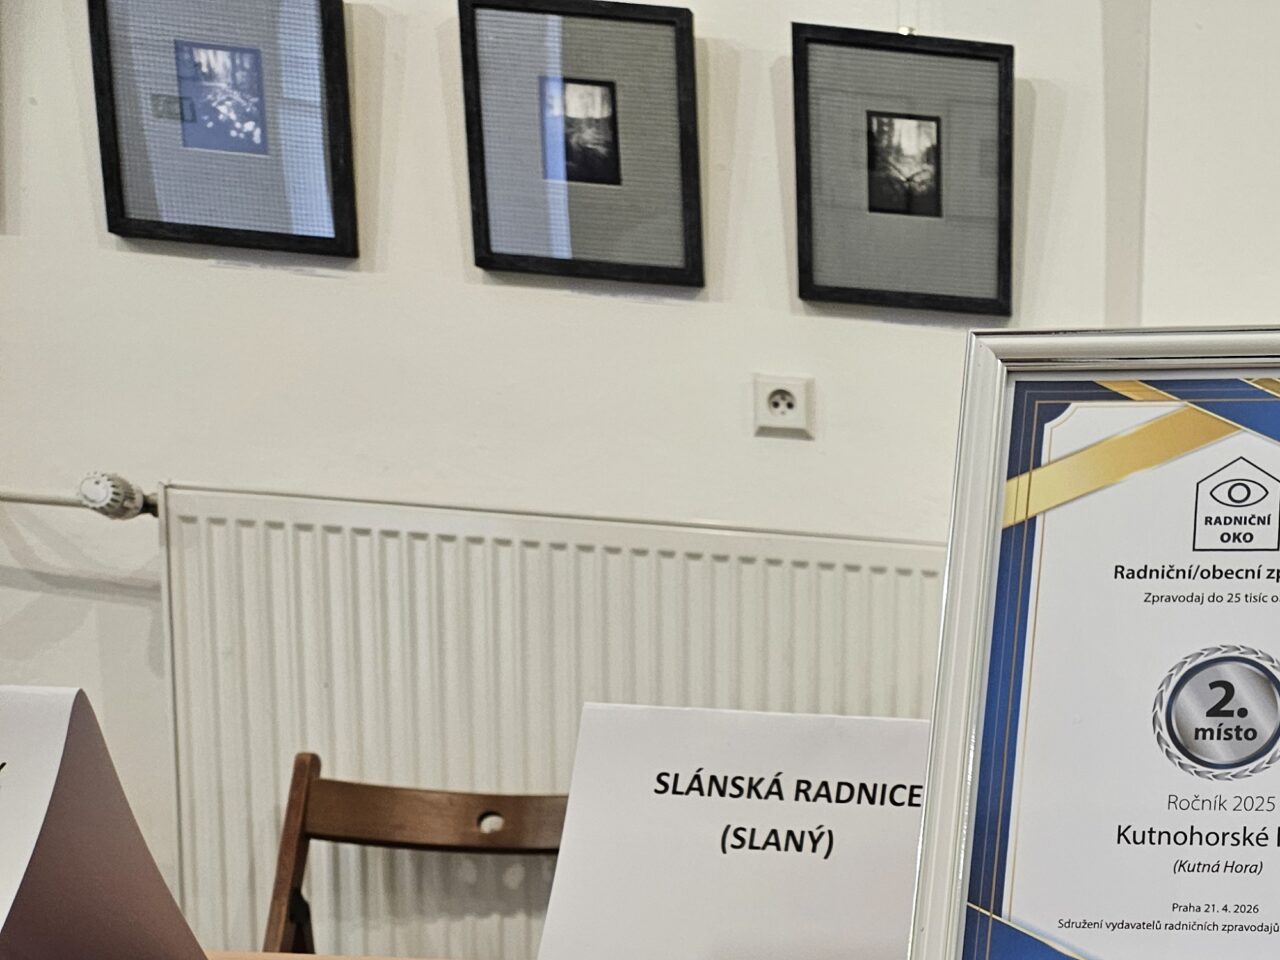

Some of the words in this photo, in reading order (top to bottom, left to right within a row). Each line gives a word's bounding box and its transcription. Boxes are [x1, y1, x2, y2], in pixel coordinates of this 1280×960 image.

[1204, 513, 1271, 526] RADNIČNÍ
[1219, 532, 1254, 543] OKO
[1114, 564, 1262, 580] Radniční/obecní
[1144, 592, 1204, 605] Zpravodaj
[1207, 592, 1224, 603] do
[1226, 592, 1241, 603] 25
[1244, 592, 1268, 603] tisíc
[1205, 680, 1249, 718] 2.
[1194, 723, 1258, 741] místo
[653, 767, 785, 802] SLÁNSKÁ
[793, 778, 924, 807] RADNICE
[1167, 794, 1228, 811] Ročník
[1232, 796, 1276, 812] 2025
[720, 824, 834, 860] (SLANÝ)
[1116, 825, 1269, 847] Kutnohorské
[1173, 859, 1220, 874] (Kutná
[1223, 860, 1264, 875] Hora)
[1172, 902, 1201, 914] Praha
[1204, 903, 1220, 914] 21.
[1222, 903, 1232, 914] 4.
[1233, 903, 1260, 914] 2026
[1057, 918, 1104, 930] Sdružení
[1105, 919, 1162, 932] vydavatelů
[1164, 920, 1219, 932] radničních
[1221, 921, 1280, 934] zpravodajů
